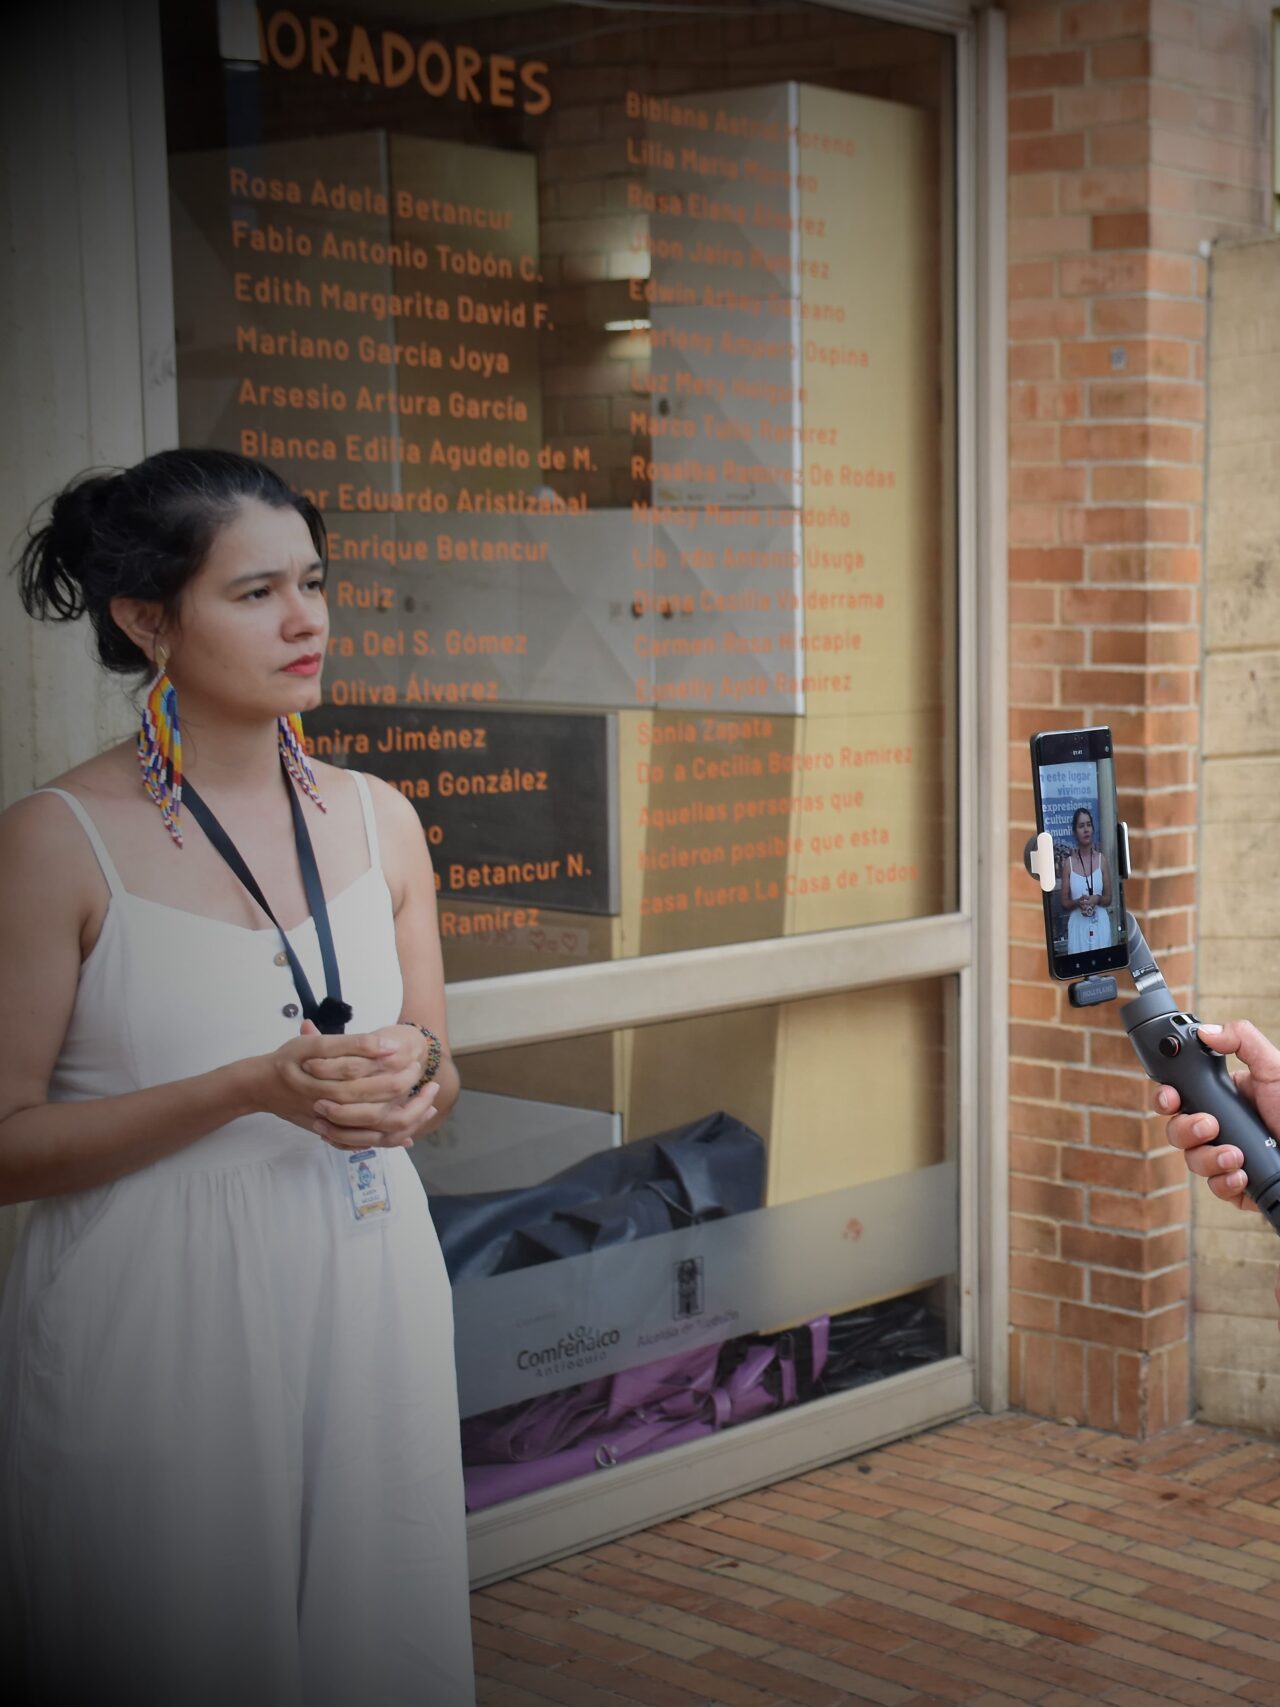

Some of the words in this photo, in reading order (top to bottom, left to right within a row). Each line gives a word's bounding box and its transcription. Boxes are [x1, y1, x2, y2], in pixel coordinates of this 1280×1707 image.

[229, 166, 300, 203] Rosa
[311, 178, 388, 216] Adela
[397, 190, 514, 231] Betancur
[231, 220, 313, 257] Fabio
[321, 231, 428, 270] Antonio
[519, 256, 543, 283] C.
[234, 272, 311, 306] Edith
[320, 284, 450, 321] Margarita
[457, 295, 526, 328] David
[533, 304, 555, 331] F.
[236, 326, 350, 362] Mariano
[450, 344, 510, 378] Joya
[806, 339, 870, 369] Ospina
[238, 378, 347, 411] Arsesio
[356, 386, 441, 417] Artura
[240, 429, 337, 460] Blanca
[345, 434, 421, 466] Edilia
[429, 439, 530, 472] Agudelo
[537, 444, 566, 470] de
[573, 446, 599, 472] M.
[810, 464, 834, 486] De
[840, 464, 896, 488] Rodas
[338, 483, 448, 513] Eduardo
[326, 532, 428, 566] Enrique
[436, 534, 548, 562] Betancur
[337, 581, 395, 608] Ruiz
[363, 630, 405, 657] Del
[412, 629, 437, 657] S.
[331, 677, 397, 706] Oliva
[302, 729, 370, 756] anira
[377, 725, 487, 753] Jiménez
[636, 720, 697, 746] Sonia
[702, 717, 774, 746] Zapata
[437, 767, 548, 797] González
[691, 753, 763, 782] Cecilia
[733, 794, 825, 824] personas
[830, 789, 864, 812] que
[637, 843, 726, 872] hicieron
[731, 835, 803, 865] posible
[810, 832, 845, 856] que
[850, 826, 890, 848] esta
[450, 857, 561, 891] Betancur
[566, 853, 592, 879] N.
[639, 891, 689, 916] casa
[694, 883, 749, 909] fuera
[754, 878, 779, 901] La
[784, 874, 831, 897] Casa
[836, 869, 860, 891] de
[865, 863, 919, 886] Todos
[516, 1328, 621, 1371] Comfenalco
